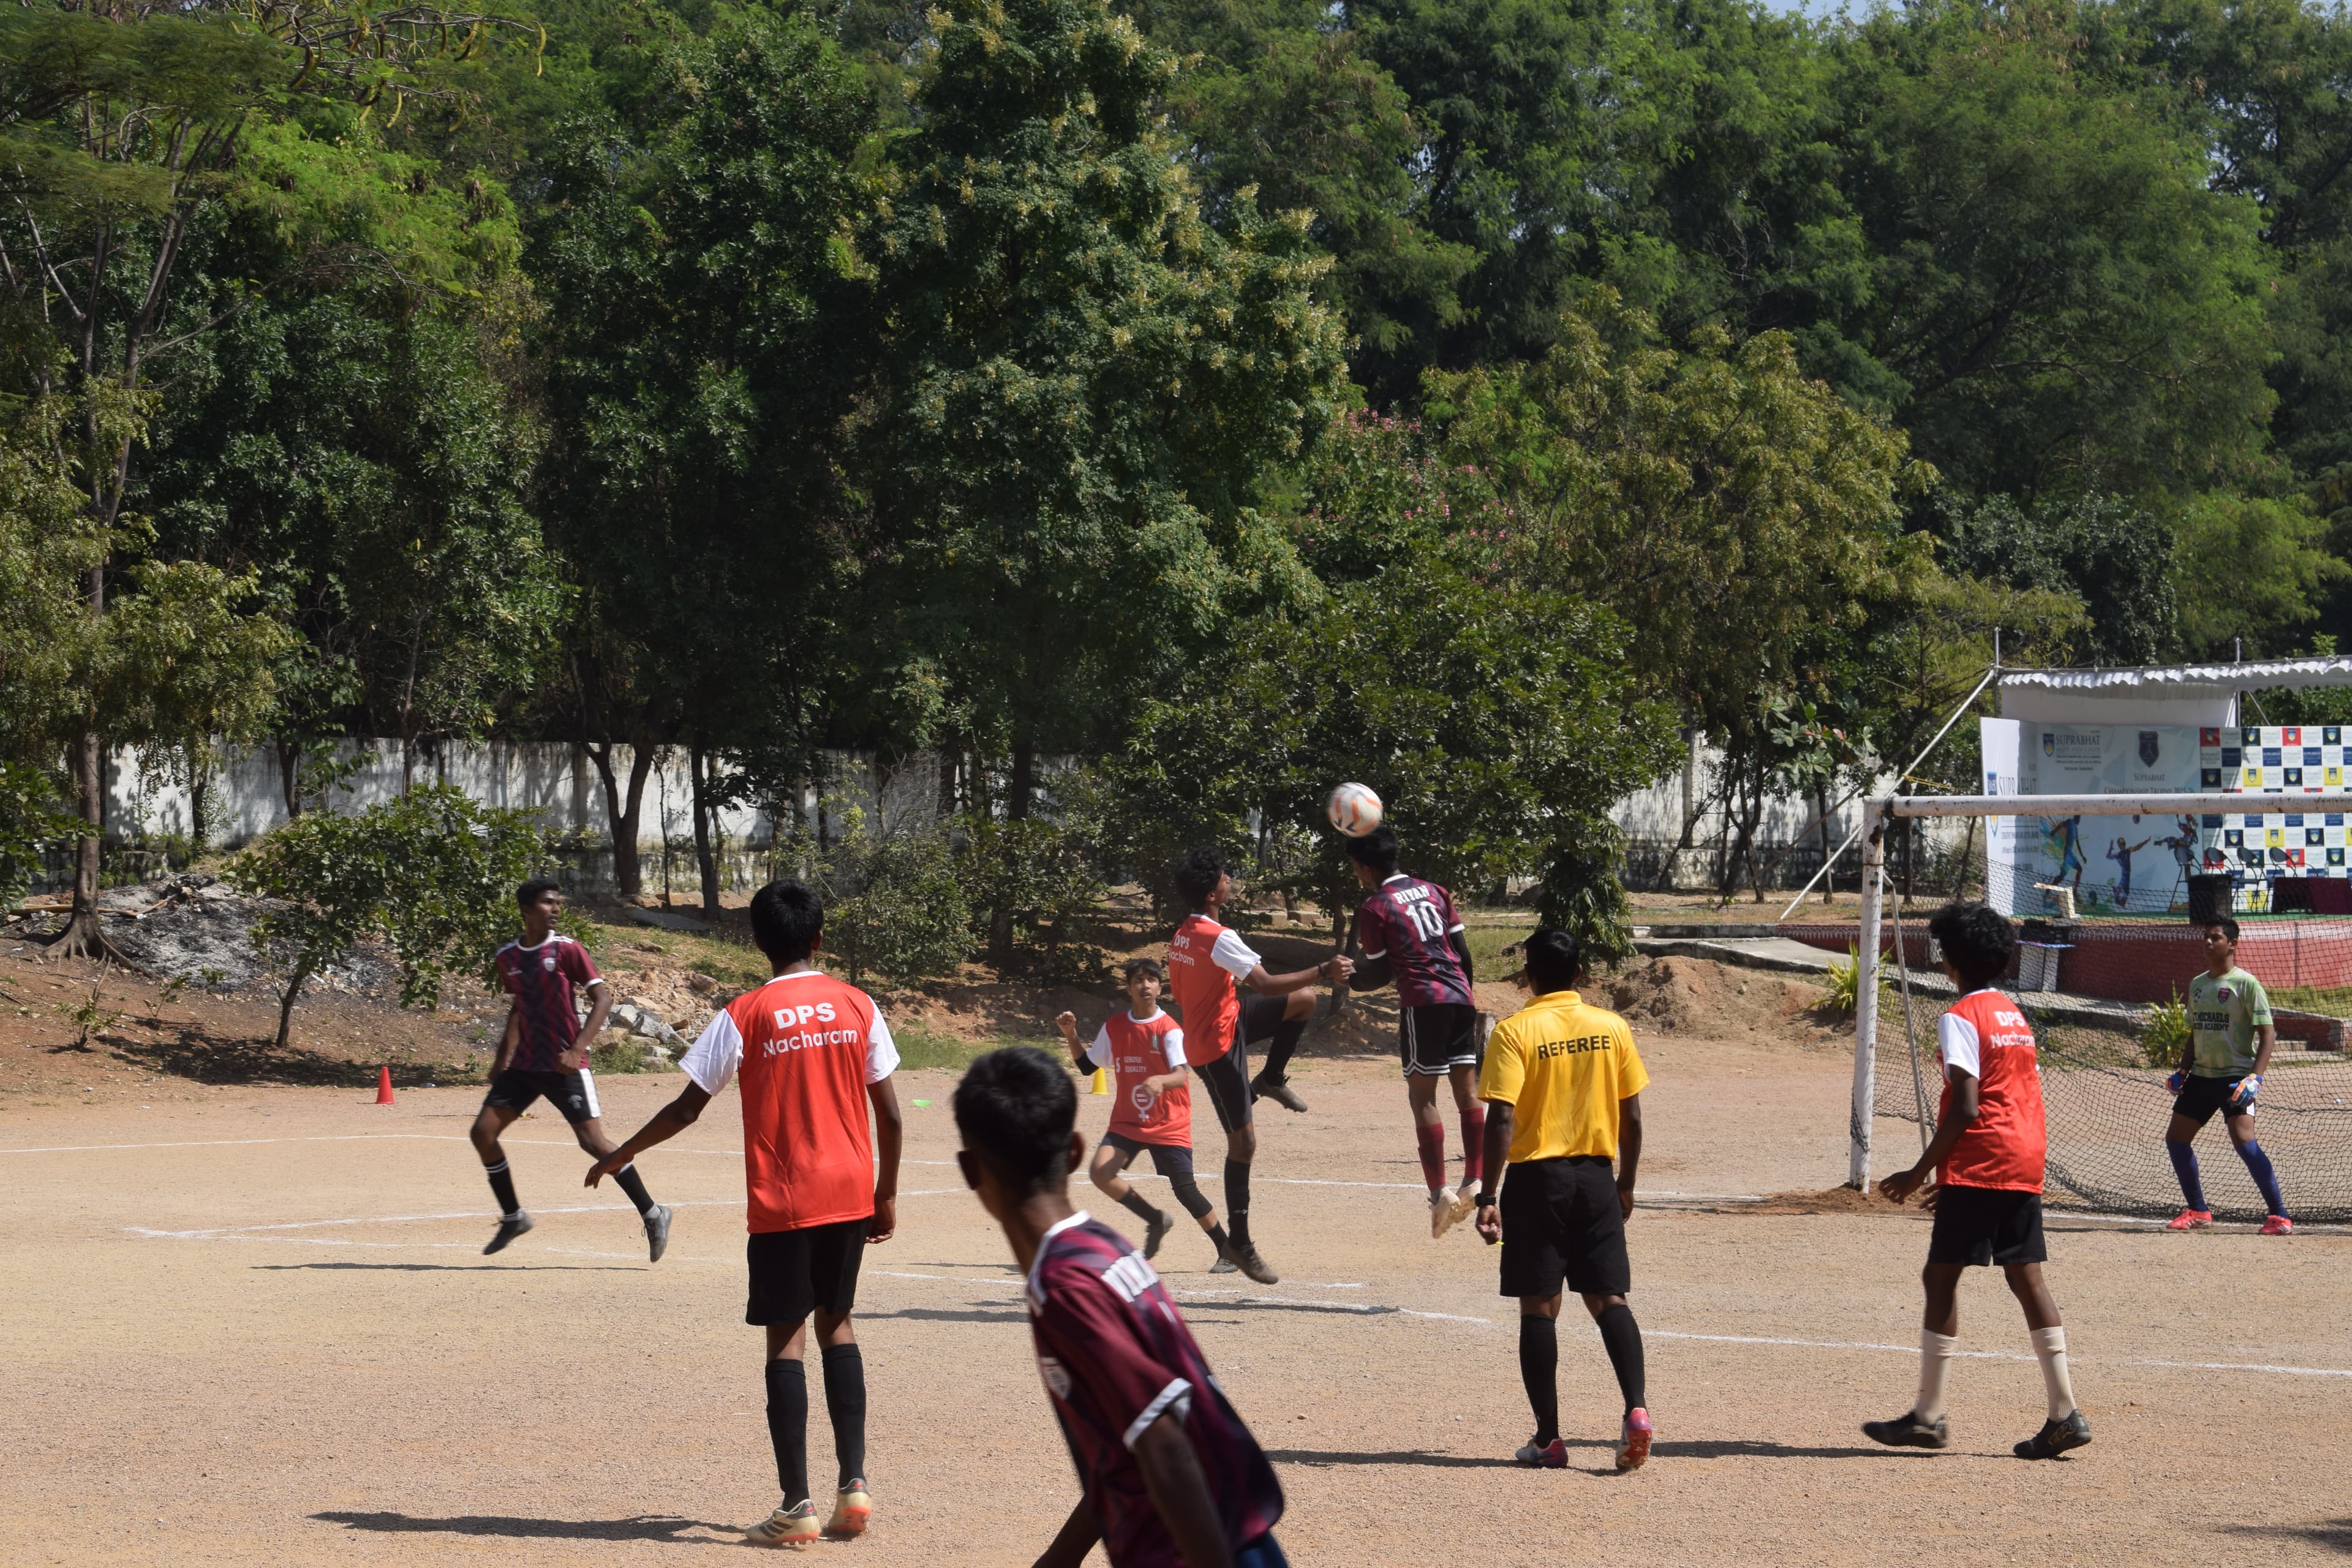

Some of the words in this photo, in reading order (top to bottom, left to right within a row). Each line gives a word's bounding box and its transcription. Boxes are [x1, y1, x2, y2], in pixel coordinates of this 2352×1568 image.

[2056, 734, 2100, 745] SUPRABHAT
[1404, 901, 1444, 942] 10
[1174, 935, 1190, 950] DPS
[774, 1002, 836, 1029] DPS
[1994, 1011, 2026, 1027] DPS
[763, 1030, 858, 1058] Nacharam
[1537, 1035, 1611, 1060] REFEREE
